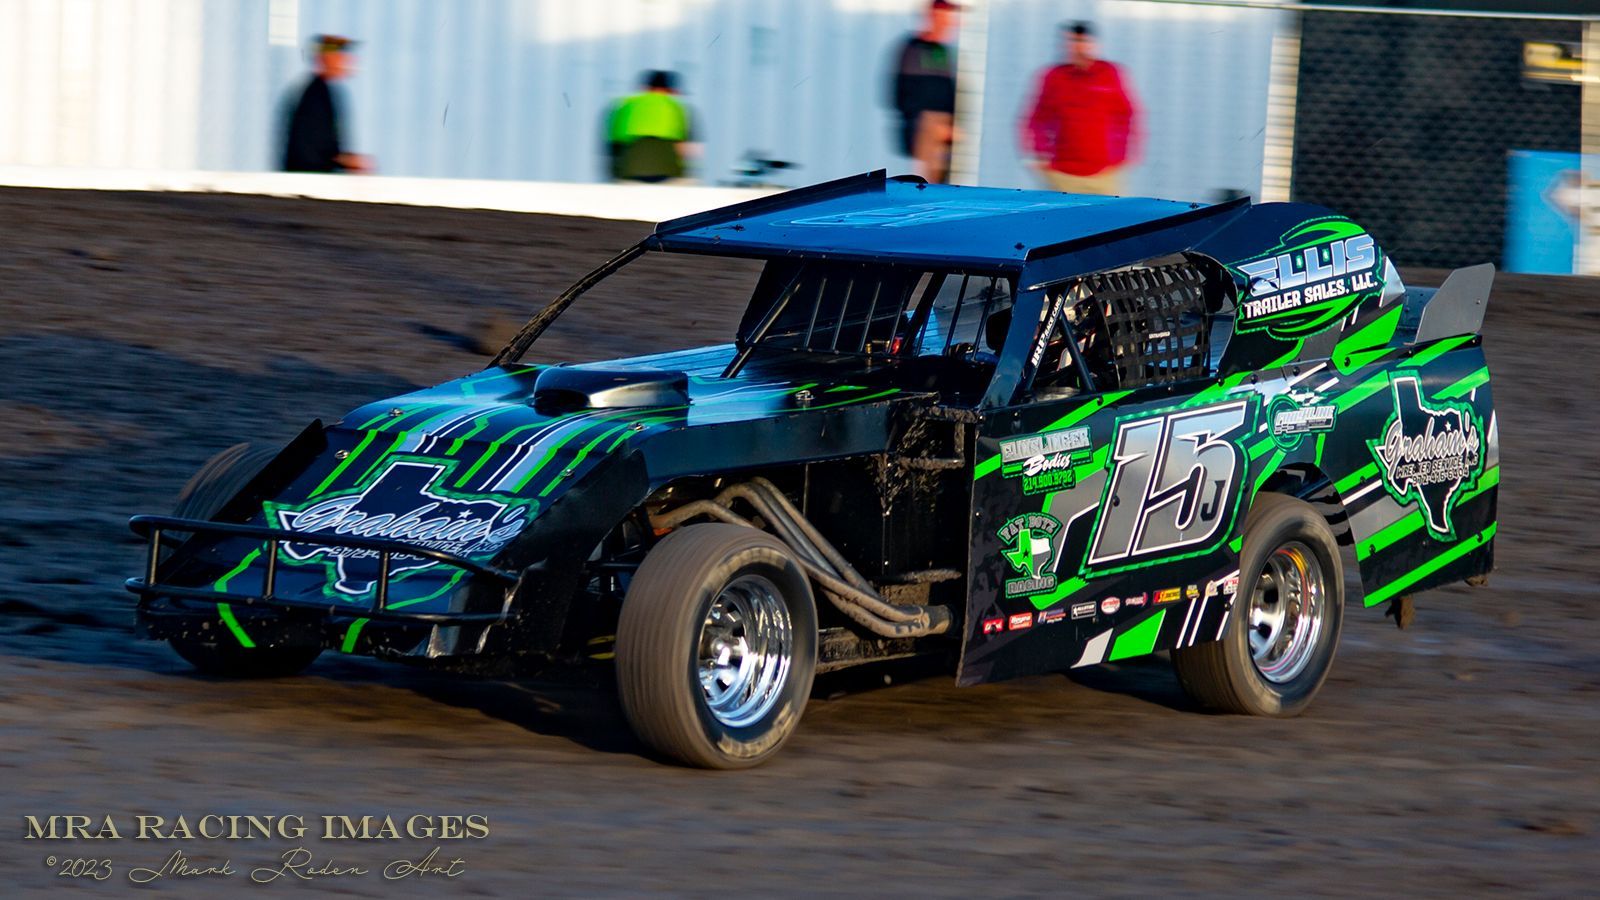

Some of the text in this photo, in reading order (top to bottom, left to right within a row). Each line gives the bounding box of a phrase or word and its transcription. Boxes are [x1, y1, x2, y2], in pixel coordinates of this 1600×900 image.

[1237, 233, 1375, 297] ELLIS
[1244, 289, 1301, 319] TRAILER
[1351, 272, 1378, 292] LLC.
[1000, 427, 1090, 462] GUNSLINGER
[1023, 453, 1072, 476] Bodies
[1384, 411, 1480, 480] Graham's
[1088, 401, 1247, 564] 15 J
[292, 495, 526, 542] Graham's
[1000, 515, 1057, 540] FAT BOYZ
[1007, 575, 1055, 595] RACING
